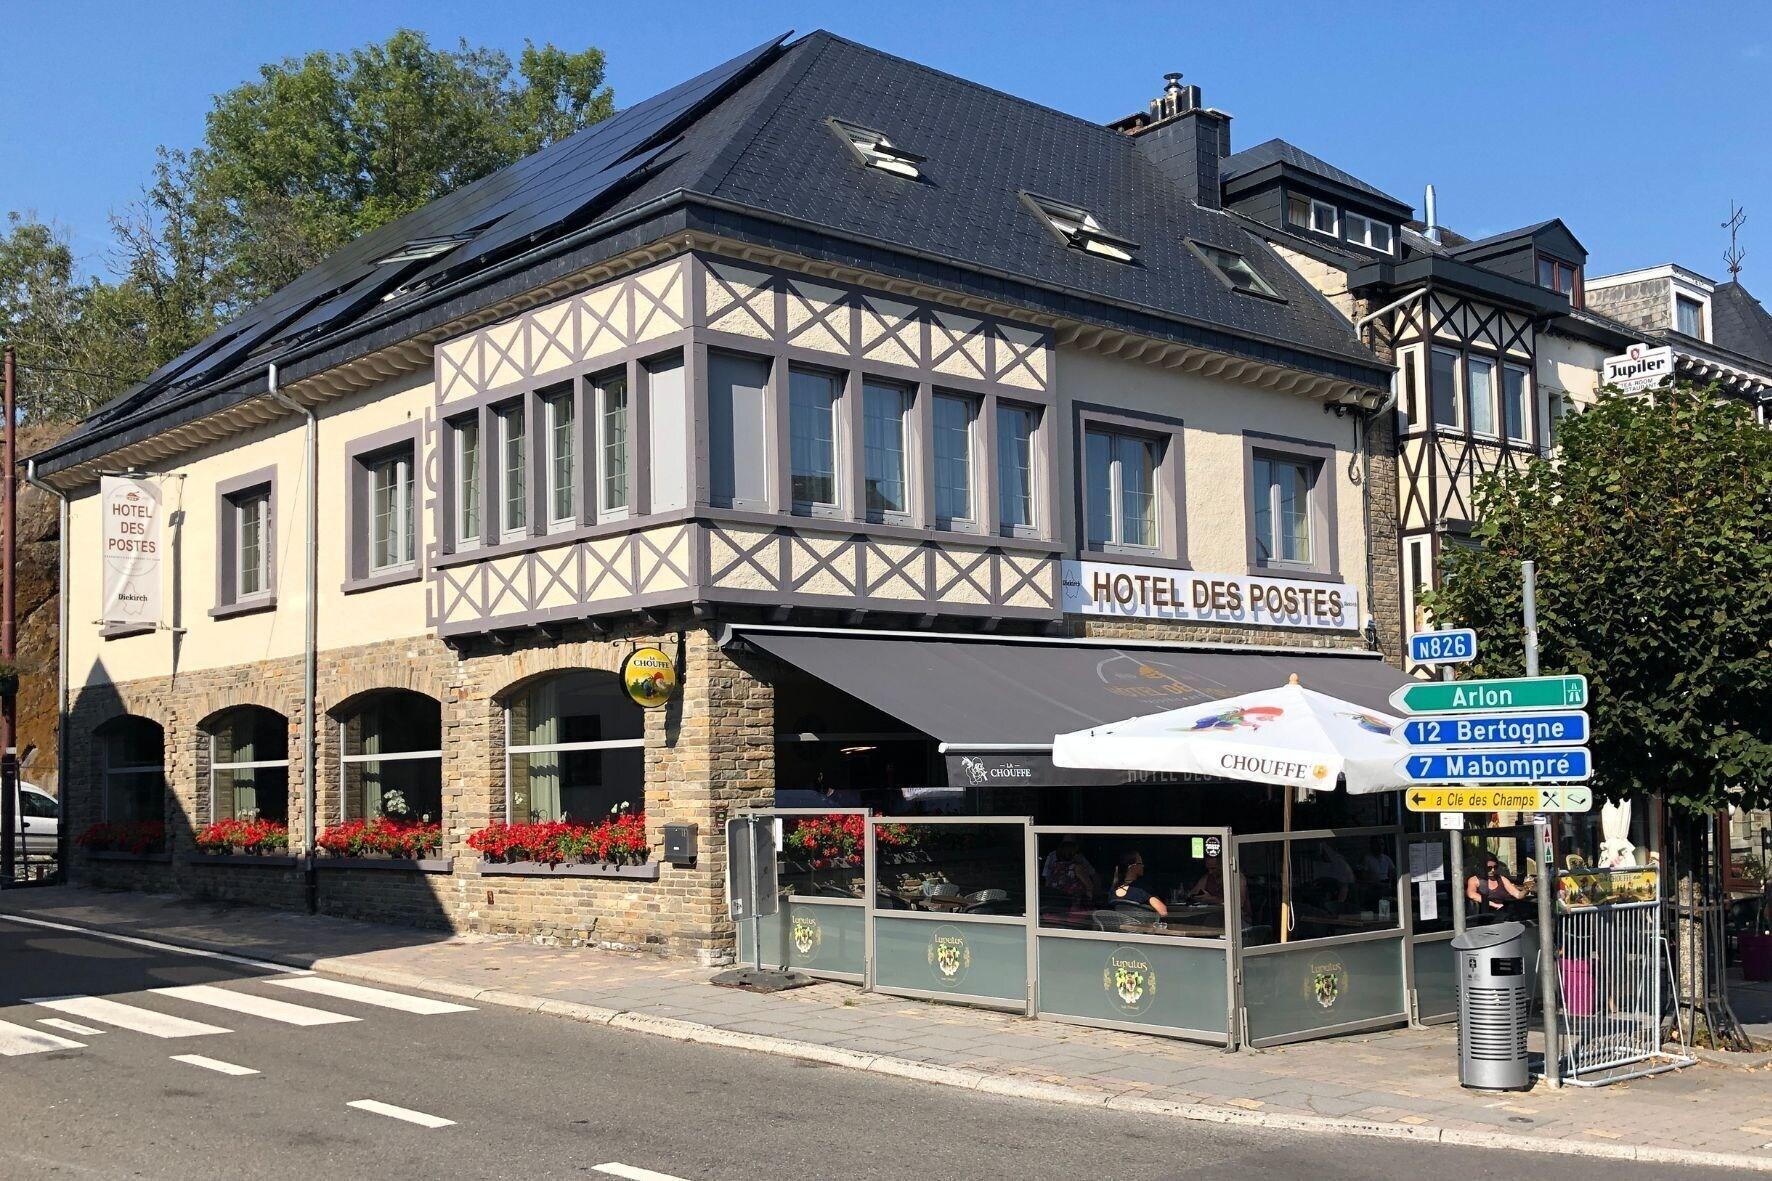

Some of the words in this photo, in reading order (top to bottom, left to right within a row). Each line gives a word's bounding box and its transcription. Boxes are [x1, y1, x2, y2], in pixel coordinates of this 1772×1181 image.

[1609, 359, 1665, 379] Jupiler
[112, 503, 153, 518] HOTEL
[120, 521, 145, 535] DES
[108, 538, 156, 554] POSTES
[118, 593, 148, 602] Diekirch
[1093, 571, 1184, 608] HOTEL
[1192, 579, 1242, 611] DES
[1249, 583, 1342, 618] POSTES
[1419, 635, 1466, 658] N826
[633, 660, 670, 669] CHOUFFE
[1452, 686, 1513, 707] Arlon
[1417, 721, 1441, 742] 12
[1457, 720, 1565, 744] Bertogne
[990, 768, 1032, 778] CHOUFFE
[1220, 753, 1308, 779] CHOUFFE
[1419, 757, 1433, 777] 7
[1446, 753, 1570, 784] Mabompré
[1447, 792, 1464, 806] Clé
[1469, 793, 1487, 806] des
[1493, 792, 1535, 811] Champs
[1111, 956, 1148, 971] Lupulus
